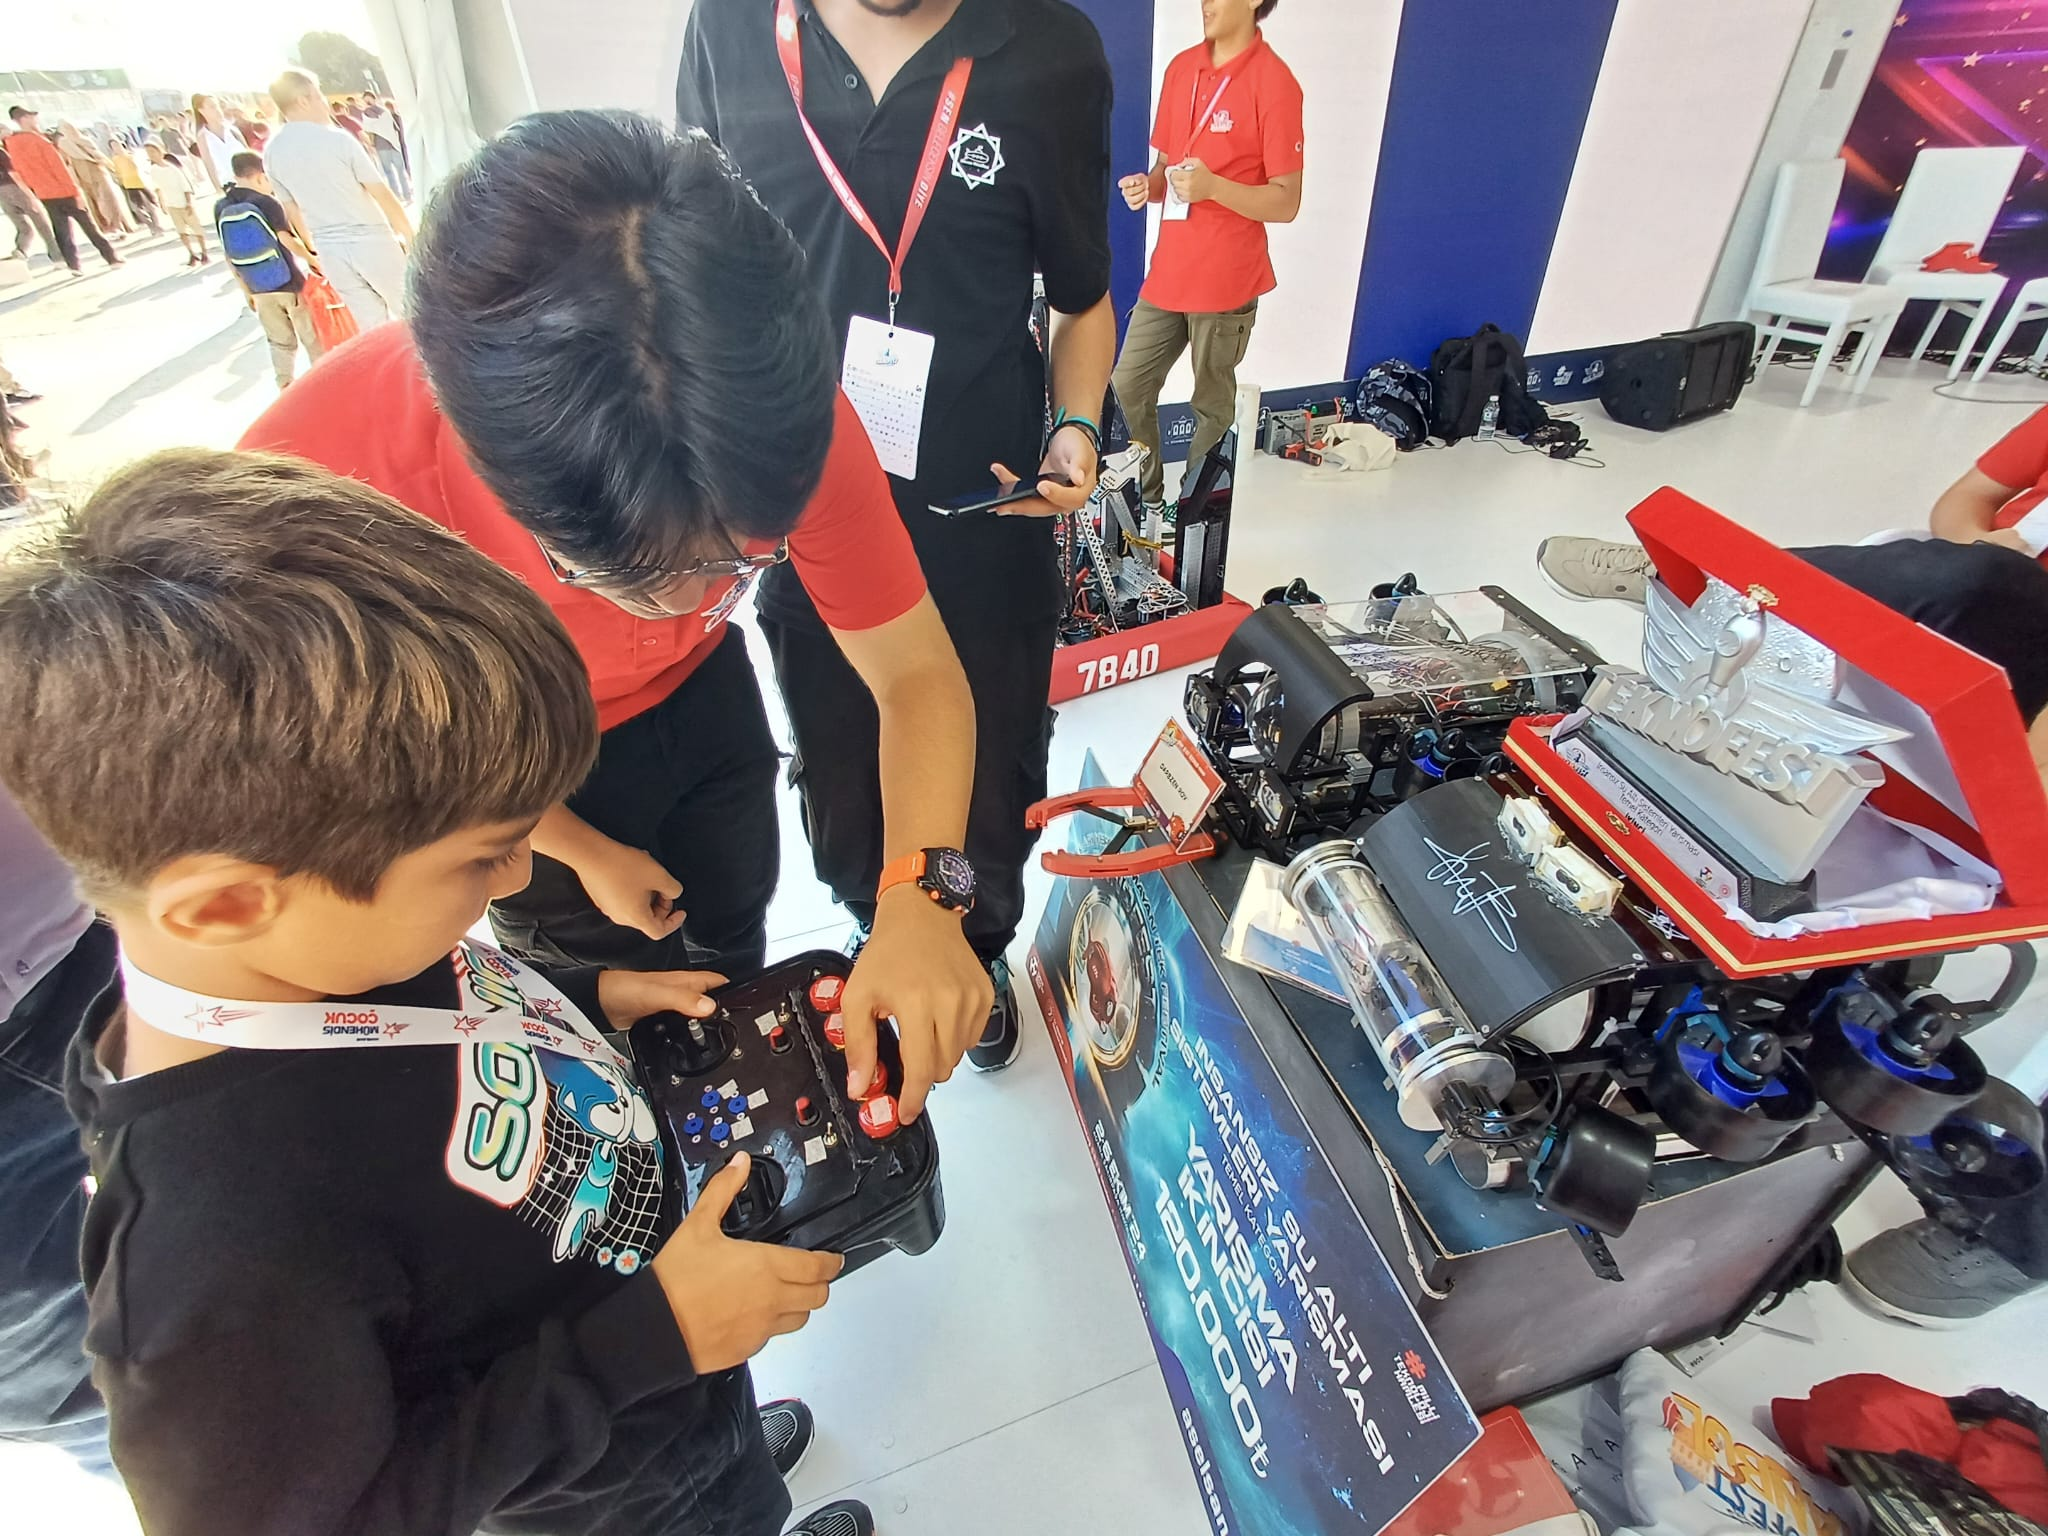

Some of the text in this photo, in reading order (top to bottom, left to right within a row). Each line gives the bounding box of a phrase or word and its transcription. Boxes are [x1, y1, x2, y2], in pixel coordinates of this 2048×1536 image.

[1077, 643, 1159, 694] 7840
[1582, 664, 1884, 818] TEKNOFEST
[1620, 793, 1664, 836] Temel Kategori
[322, 1026, 379, 1036] MÜHENDİS
[323, 1009, 379, 1024] ÇOCUK
[1220, 1155, 1244, 1205] TEMEL
[1186, 1120, 1299, 1396] YARIŞMA
[1281, 1209, 1317, 1273] SU
[1314, 1285, 1373, 1385] ALTI
[1266, 1206, 1395, 1475] YARIŞMASI
[1181, 1407, 1229, 1536] aselsan
